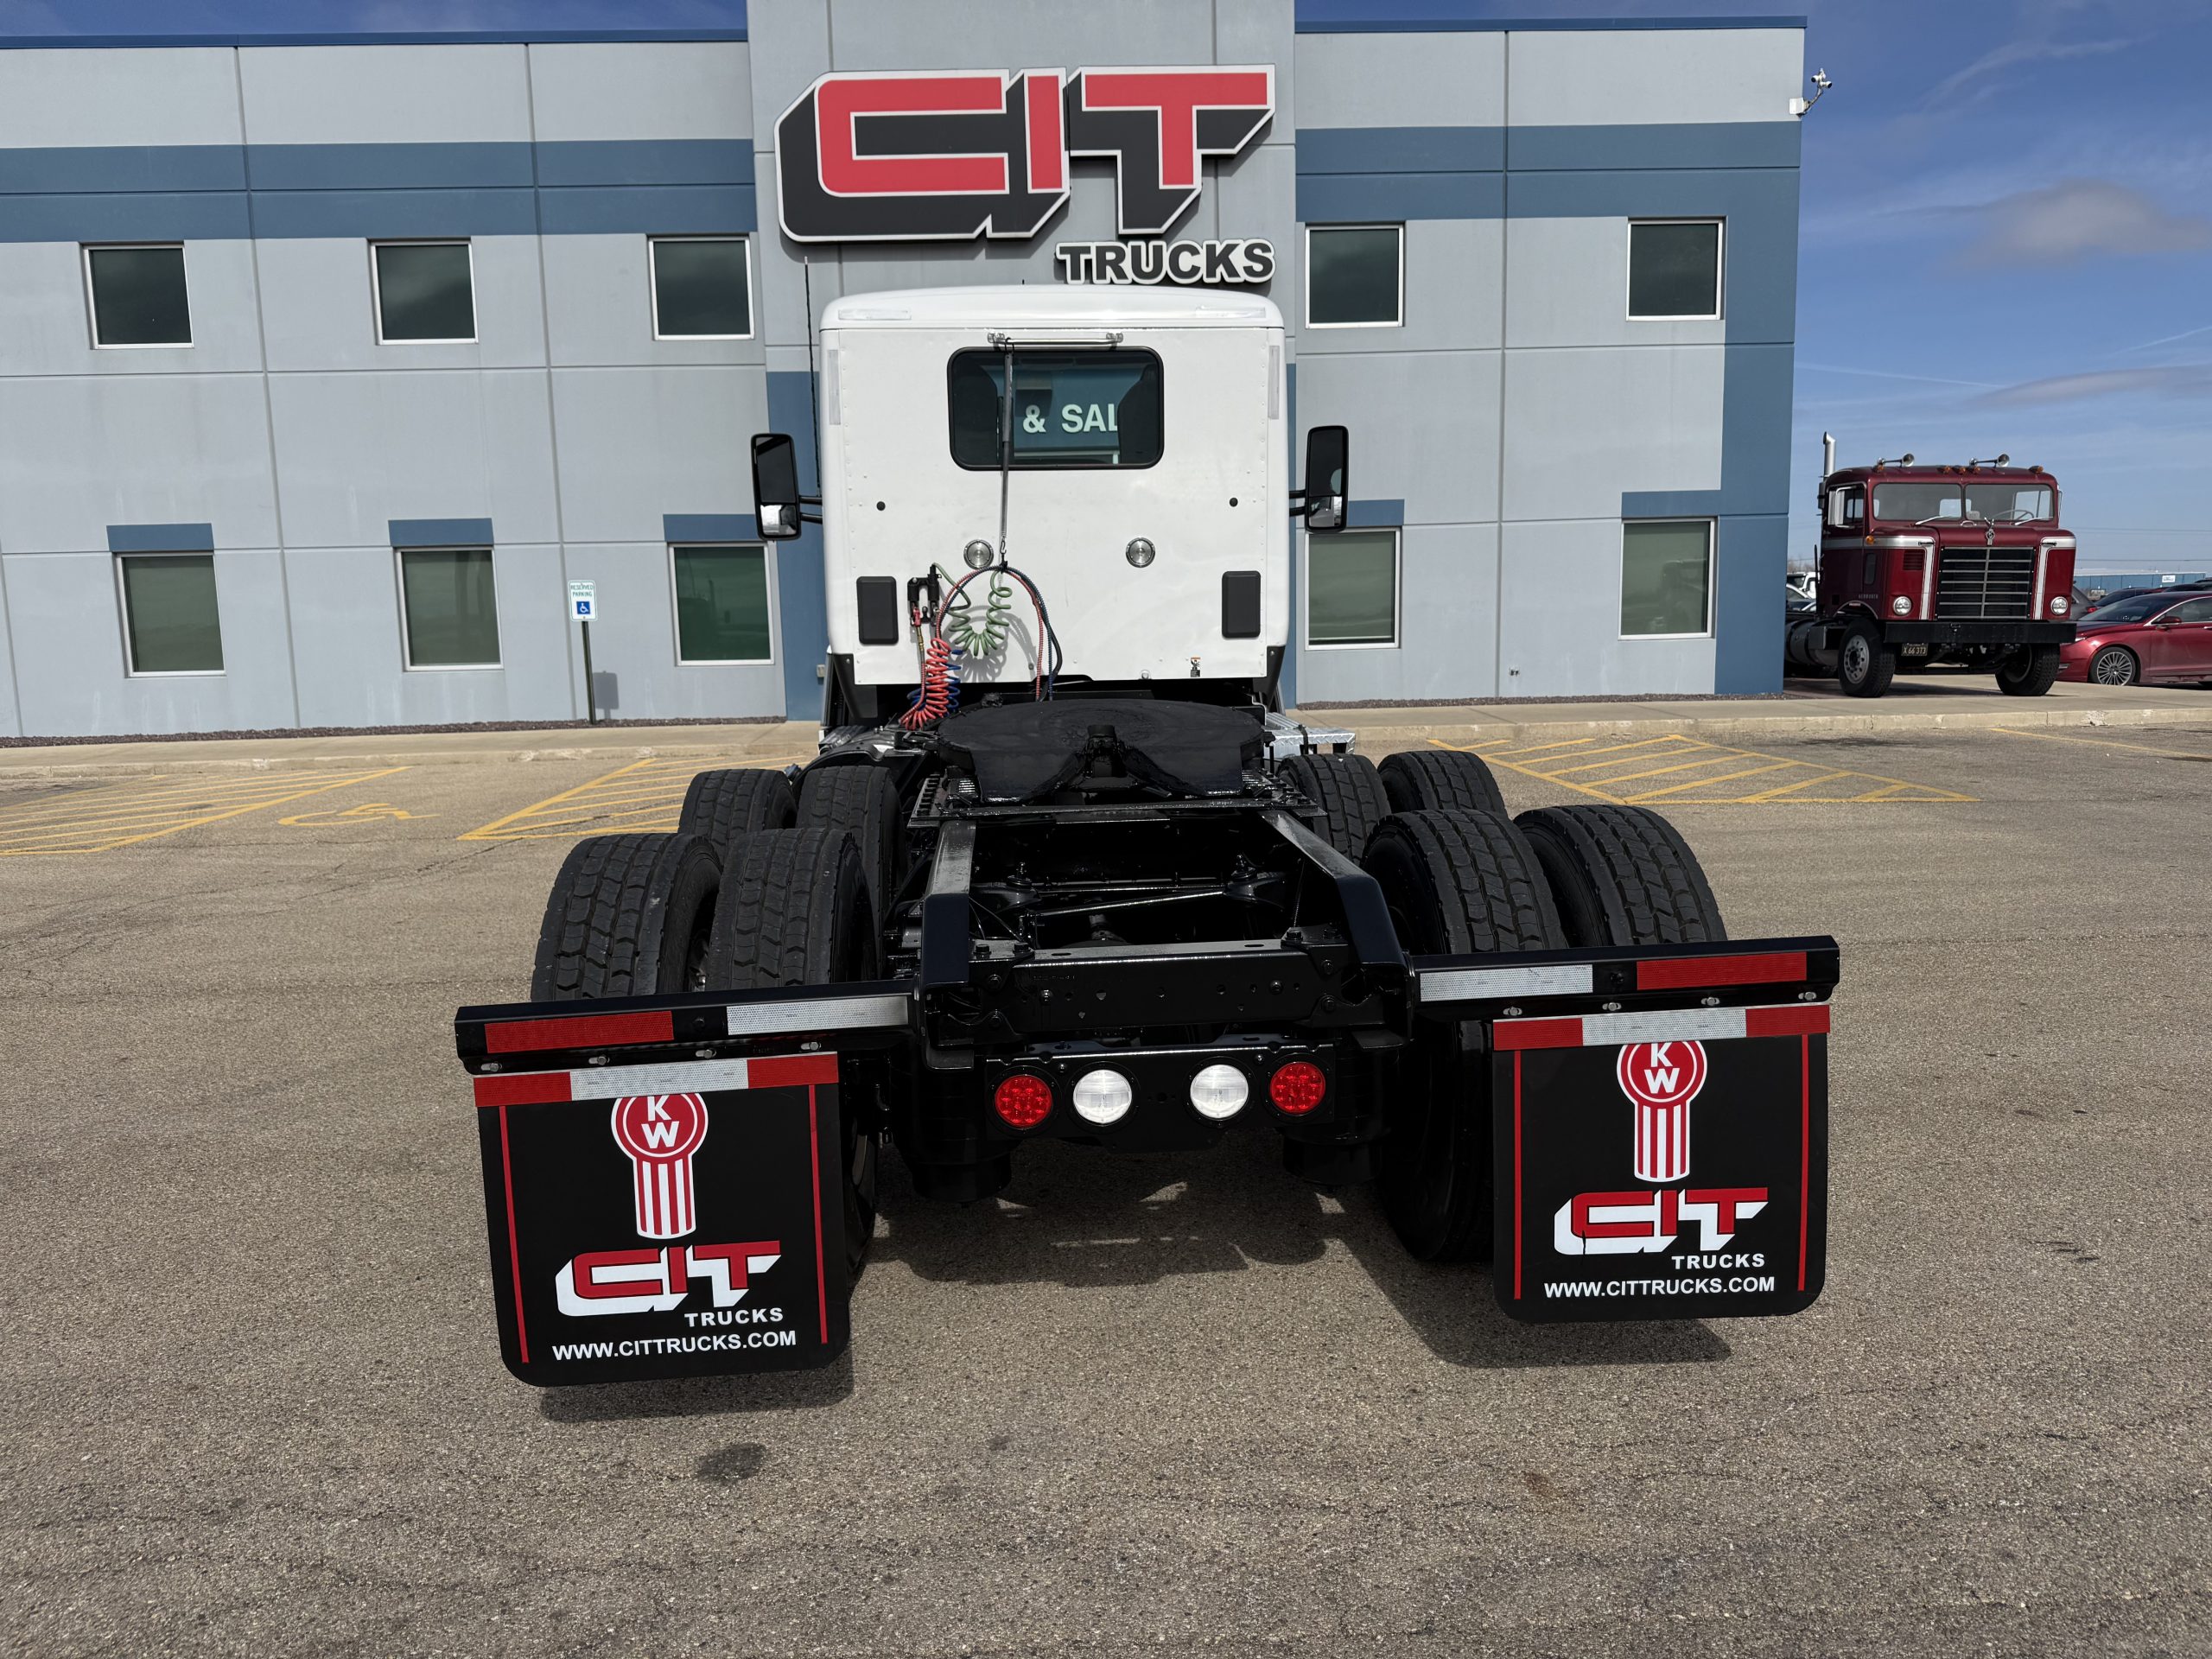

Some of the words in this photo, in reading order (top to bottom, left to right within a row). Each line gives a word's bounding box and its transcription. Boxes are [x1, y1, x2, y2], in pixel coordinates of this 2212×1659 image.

[775, 65, 1275, 242] CIT
[1056, 239, 1275, 284] TRUCKS
[1022, 404, 1046, 433] &
[1554, 1187, 1769, 1255] CIT
[1671, 1253, 1765, 1269] TRUCKS
[556, 1240, 781, 1317] CIT
[1544, 1276, 1776, 1298] WWW.CITTRUCKS.COM
[684, 1307, 784, 1327] TRUCKS
[552, 1331, 797, 1361] WWW.CITTRUCKS.COM
